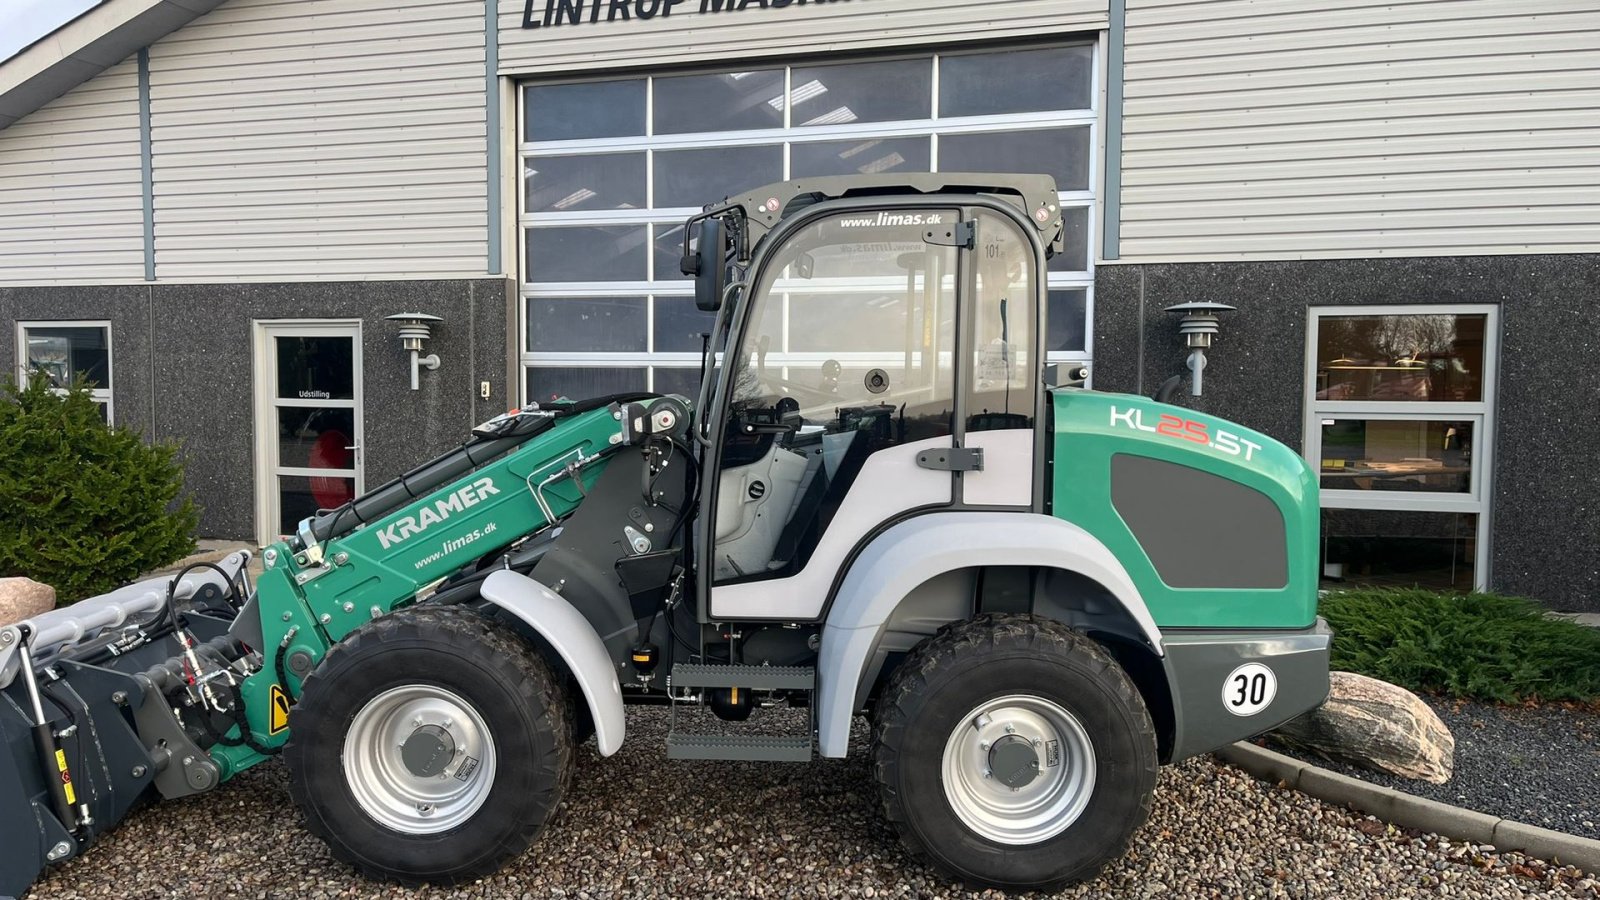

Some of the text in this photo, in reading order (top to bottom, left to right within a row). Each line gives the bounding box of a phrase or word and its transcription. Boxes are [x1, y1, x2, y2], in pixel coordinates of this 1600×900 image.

[840, 213, 943, 227] www.limas.dk
[299, 390, 330, 399] Udstilling
[1110, 405, 1262, 461] KL25.5T
[376, 477, 501, 549] KRAMER
[414, 522, 497, 569] www.limas.dk
[1232, 673, 1266, 706] 30
